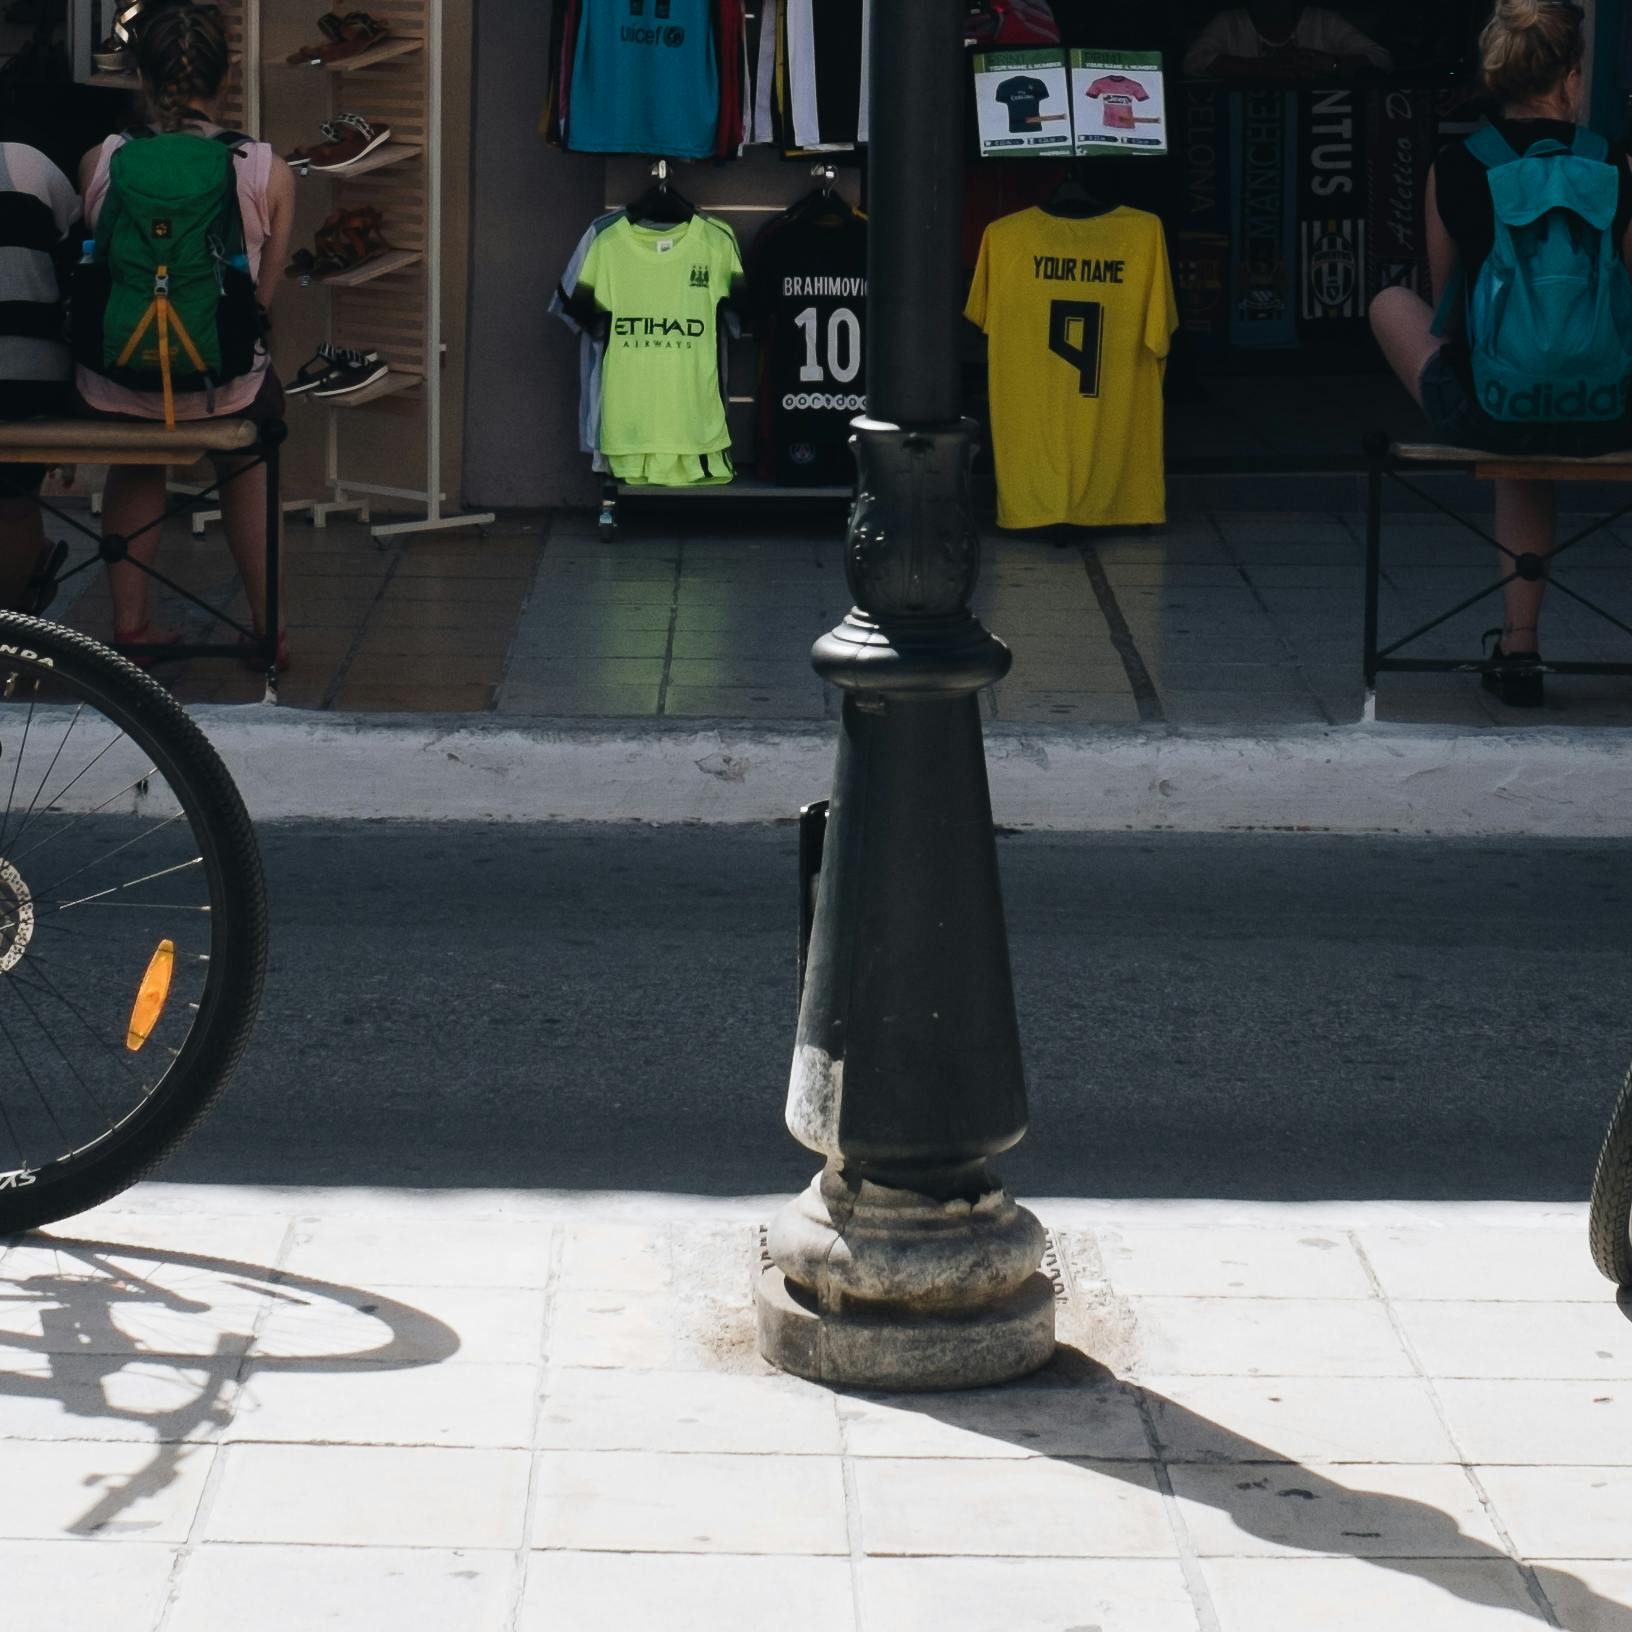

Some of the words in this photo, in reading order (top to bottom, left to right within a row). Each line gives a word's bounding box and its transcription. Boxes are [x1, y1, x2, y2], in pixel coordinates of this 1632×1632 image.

[1033, 254, 1077, 283] YOUR
[1079, 258, 1125, 284] NAME
[614, 317, 705, 337] ETIHAD
[623, 340, 692, 350] AIRWAYS
[793, 306, 862, 384] 10
[1048, 299, 1105, 398] 9
